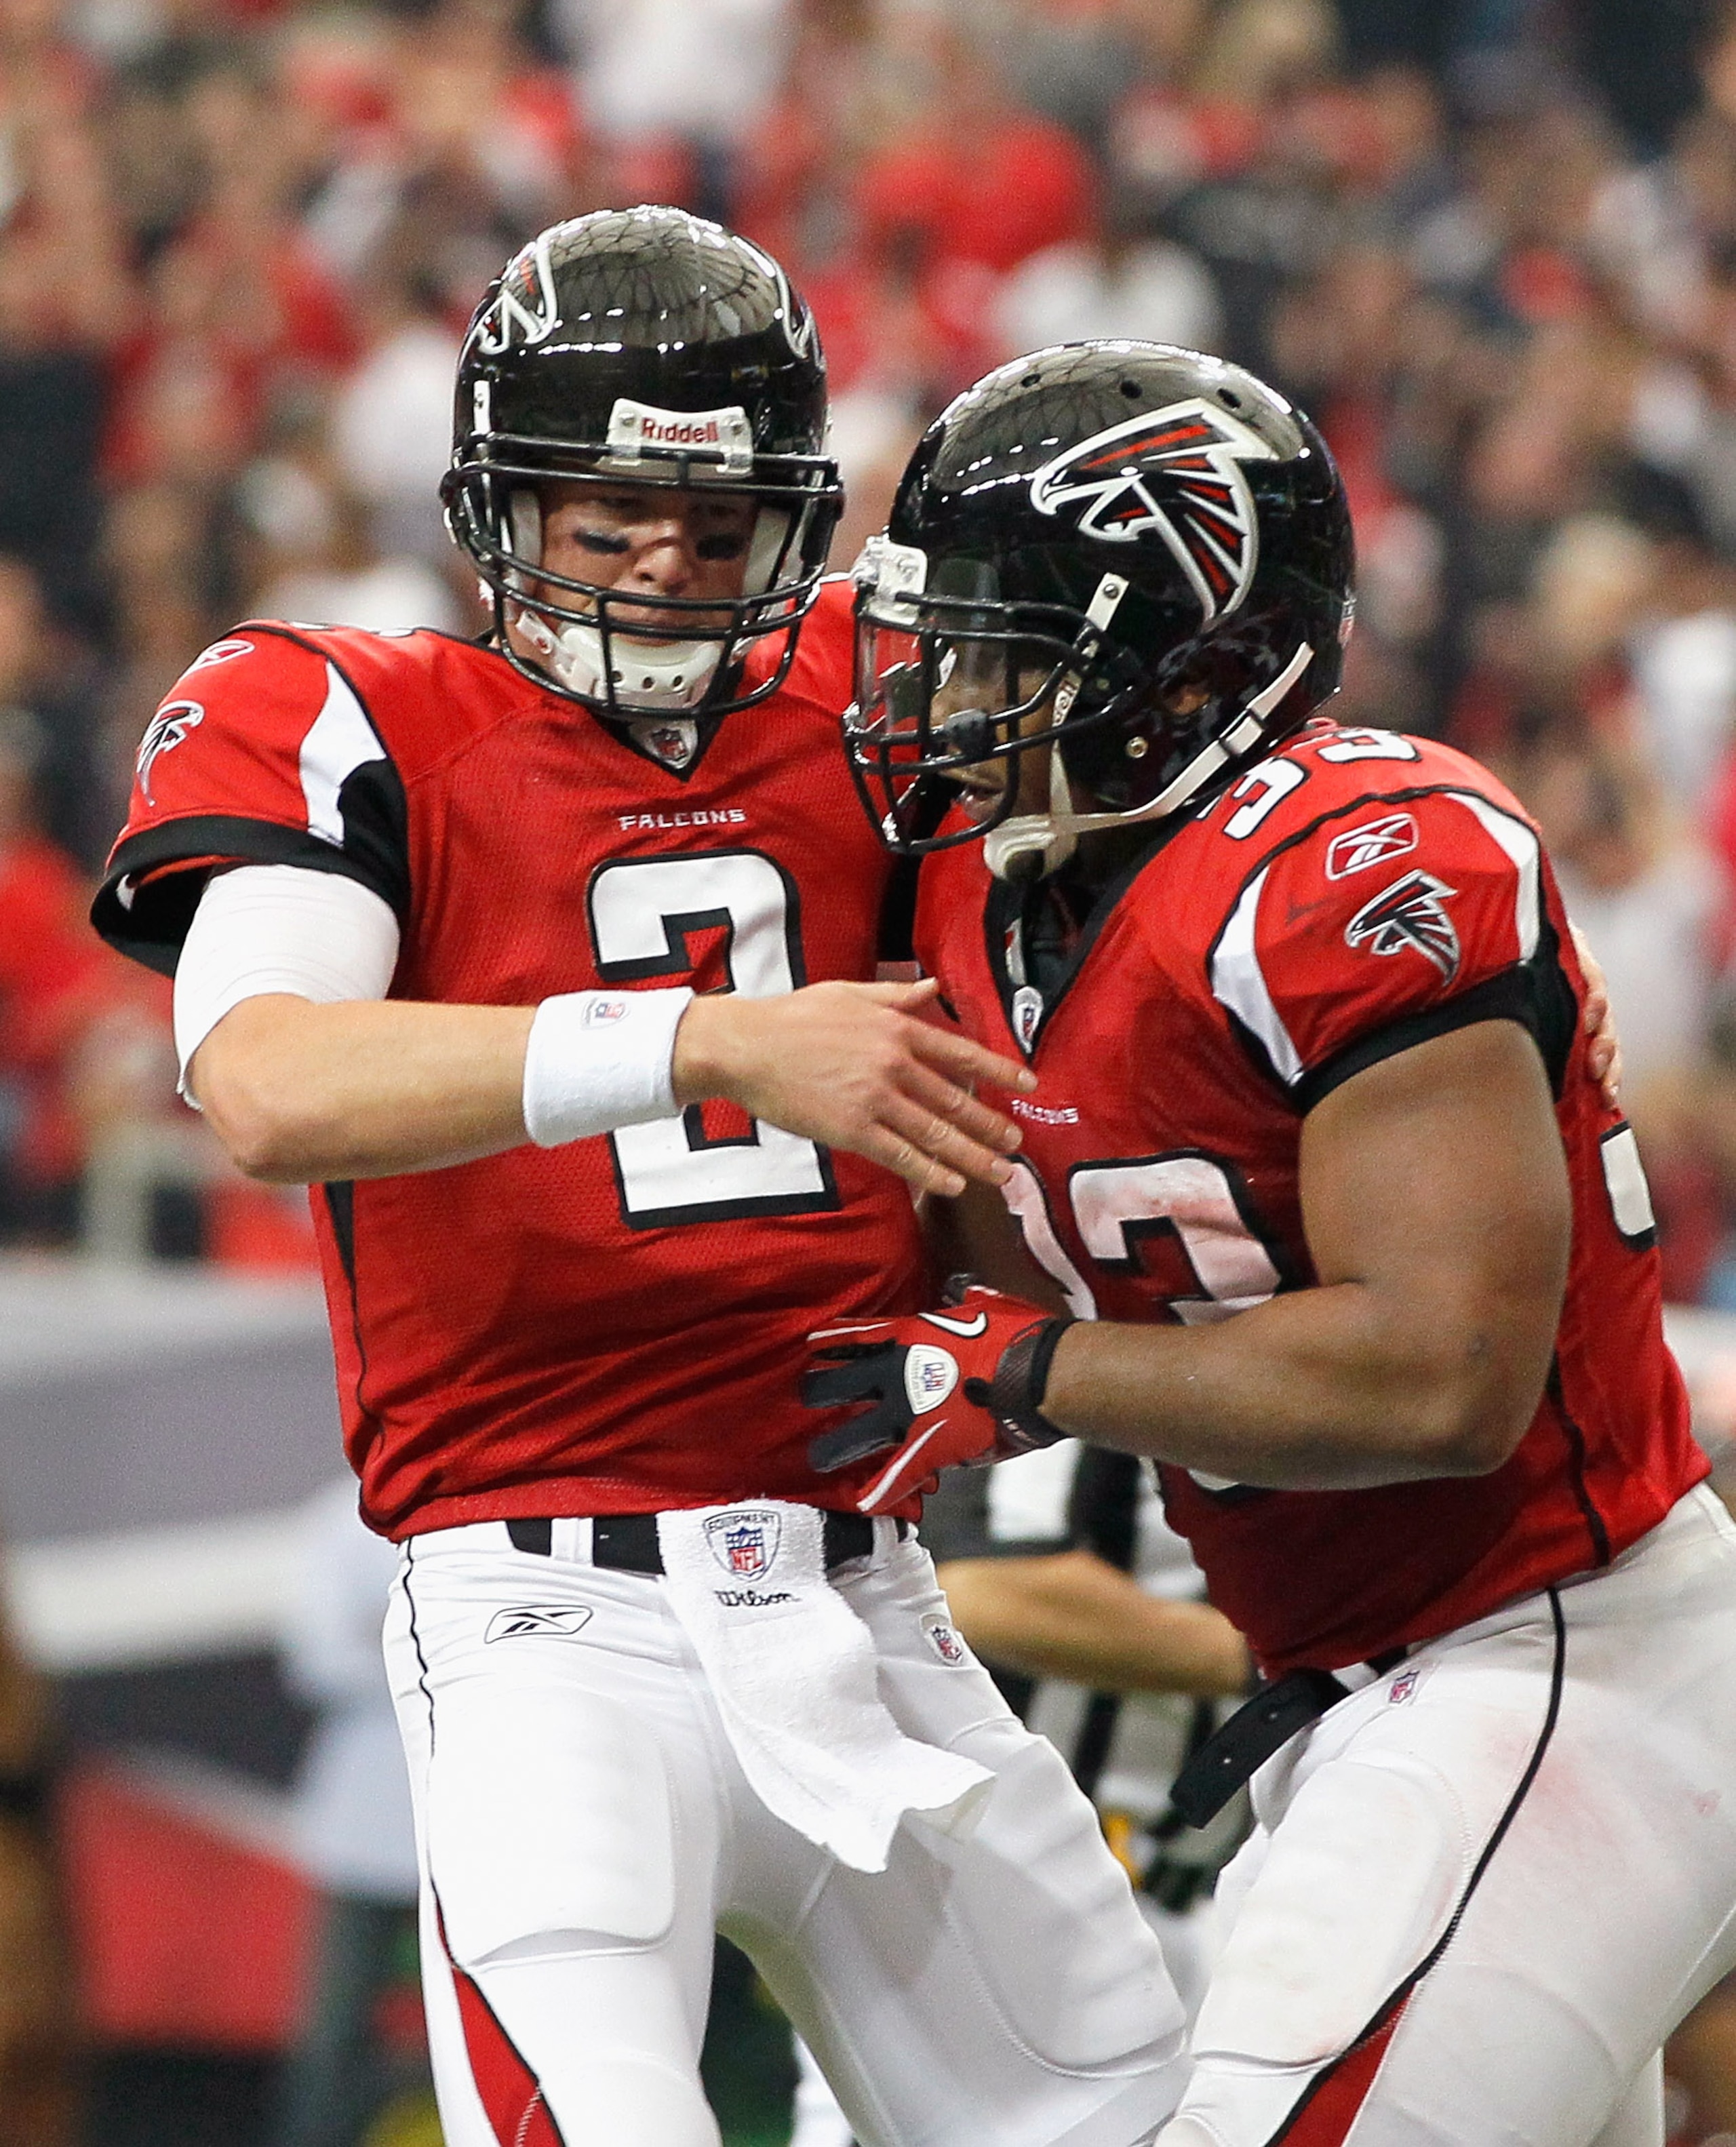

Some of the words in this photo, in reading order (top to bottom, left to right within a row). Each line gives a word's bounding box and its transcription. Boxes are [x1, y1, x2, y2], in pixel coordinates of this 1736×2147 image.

[642, 417, 719, 443] Riddell
[618, 808, 746, 831] FALCONS
[589, 848, 841, 1229] 2
[714, 1589, 802, 1607] Wilson
